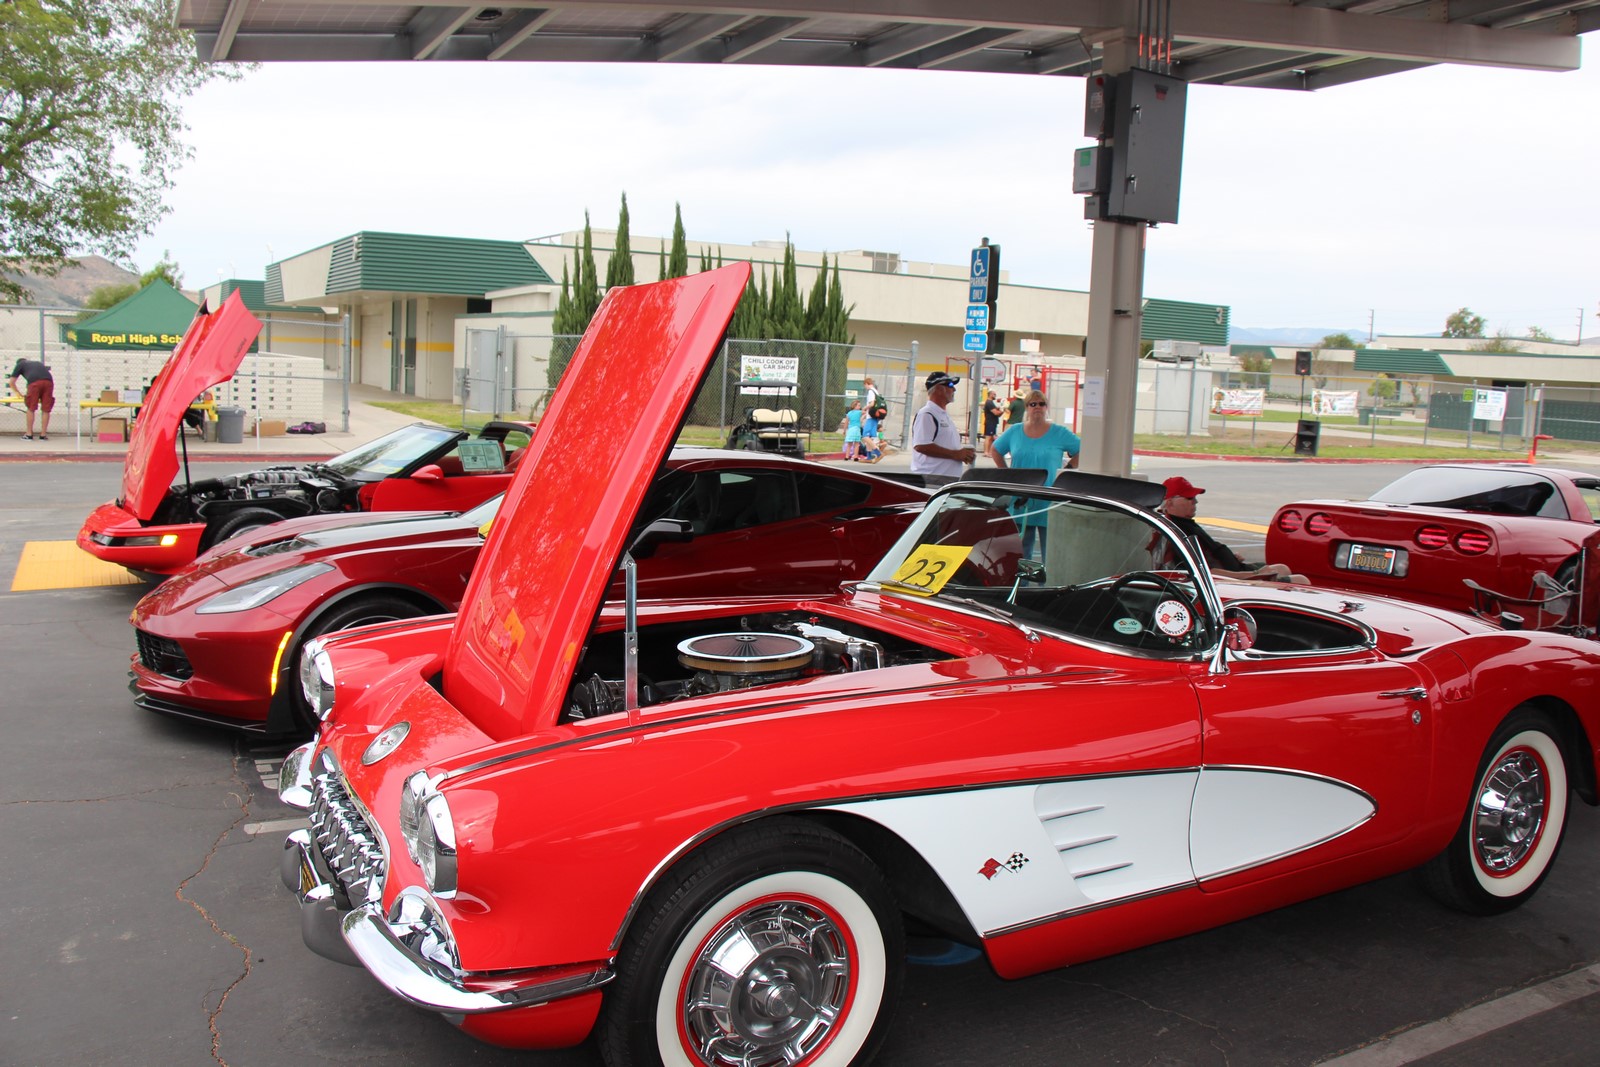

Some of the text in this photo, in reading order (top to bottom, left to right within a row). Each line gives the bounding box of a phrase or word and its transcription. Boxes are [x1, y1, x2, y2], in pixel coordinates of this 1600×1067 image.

[970, 276, 988, 287] PARKING
[1215, 307, 1223, 324] 3
[91, 333, 126, 345] Royal
[129, 334, 157, 345] High
[900, 558, 947, 588] 23
[1168, 602, 1186, 612] VALLEY
